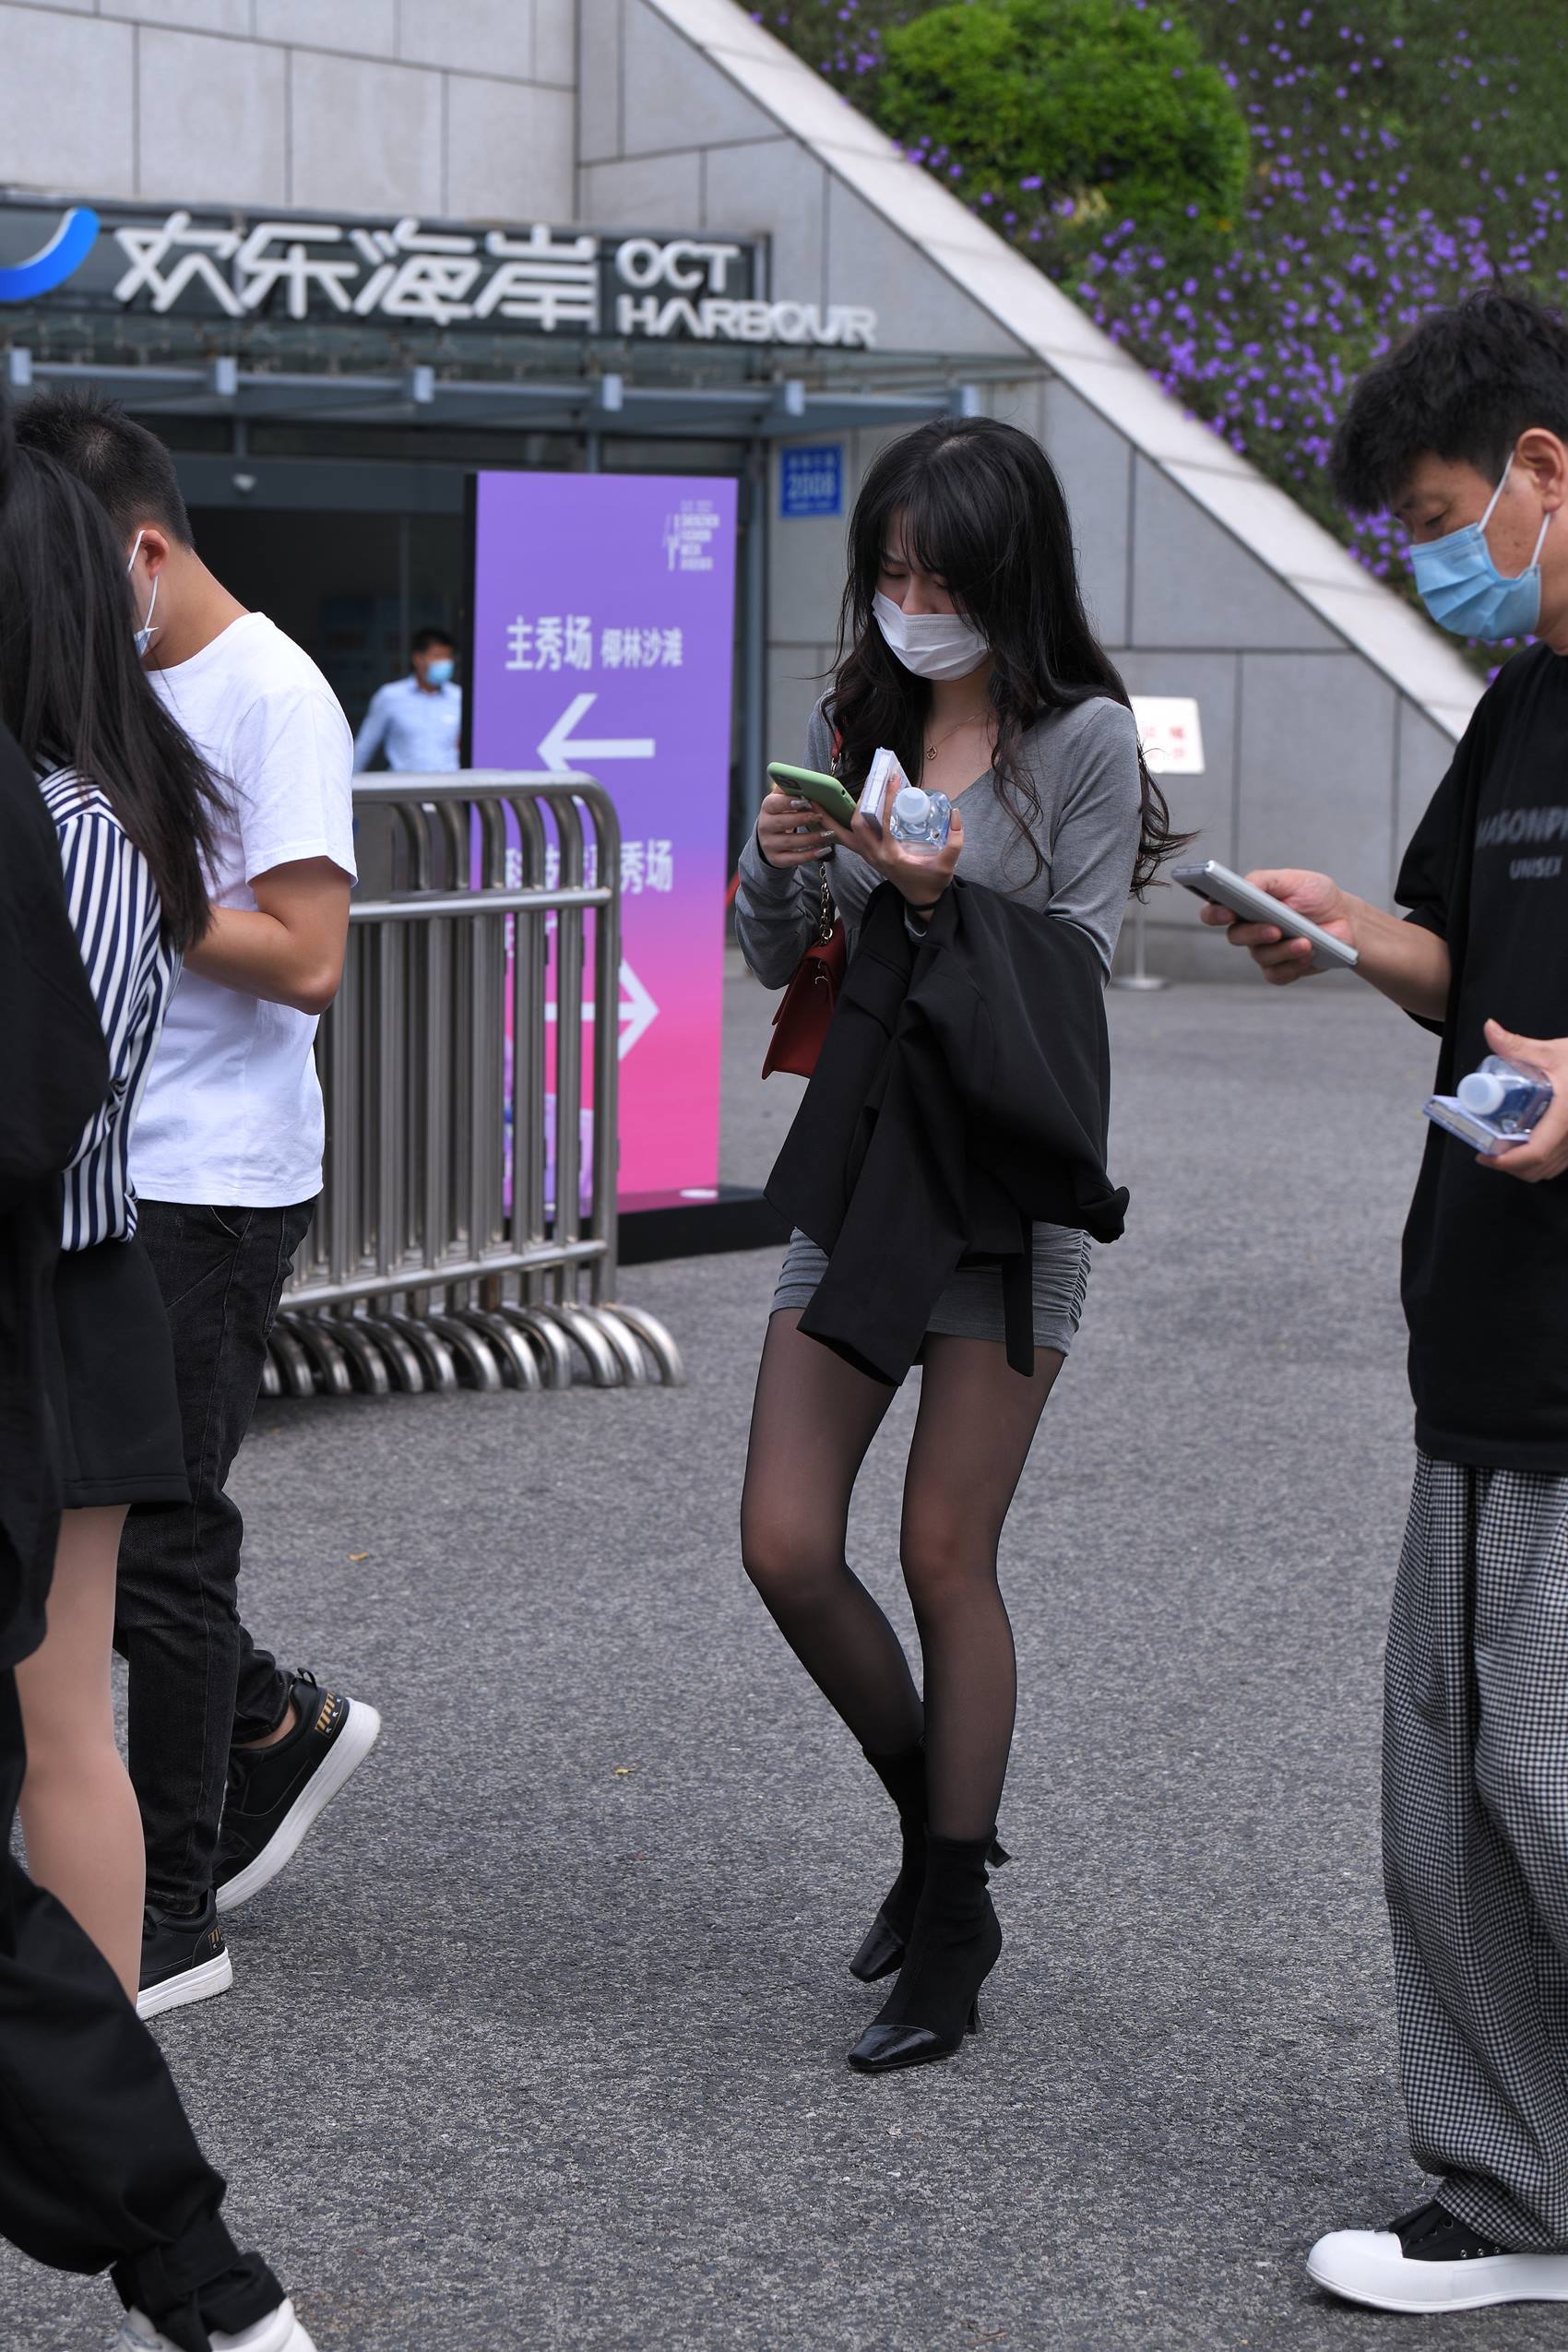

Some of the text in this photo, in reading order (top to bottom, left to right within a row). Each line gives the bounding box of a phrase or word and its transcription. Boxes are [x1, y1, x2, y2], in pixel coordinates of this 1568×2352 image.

[113, 209, 597, 332] 欢乐海岸
[615, 238, 739, 293] OCT
[615, 293, 878, 350] HARBOUR
[505, 614, 592, 671] 主秀场
